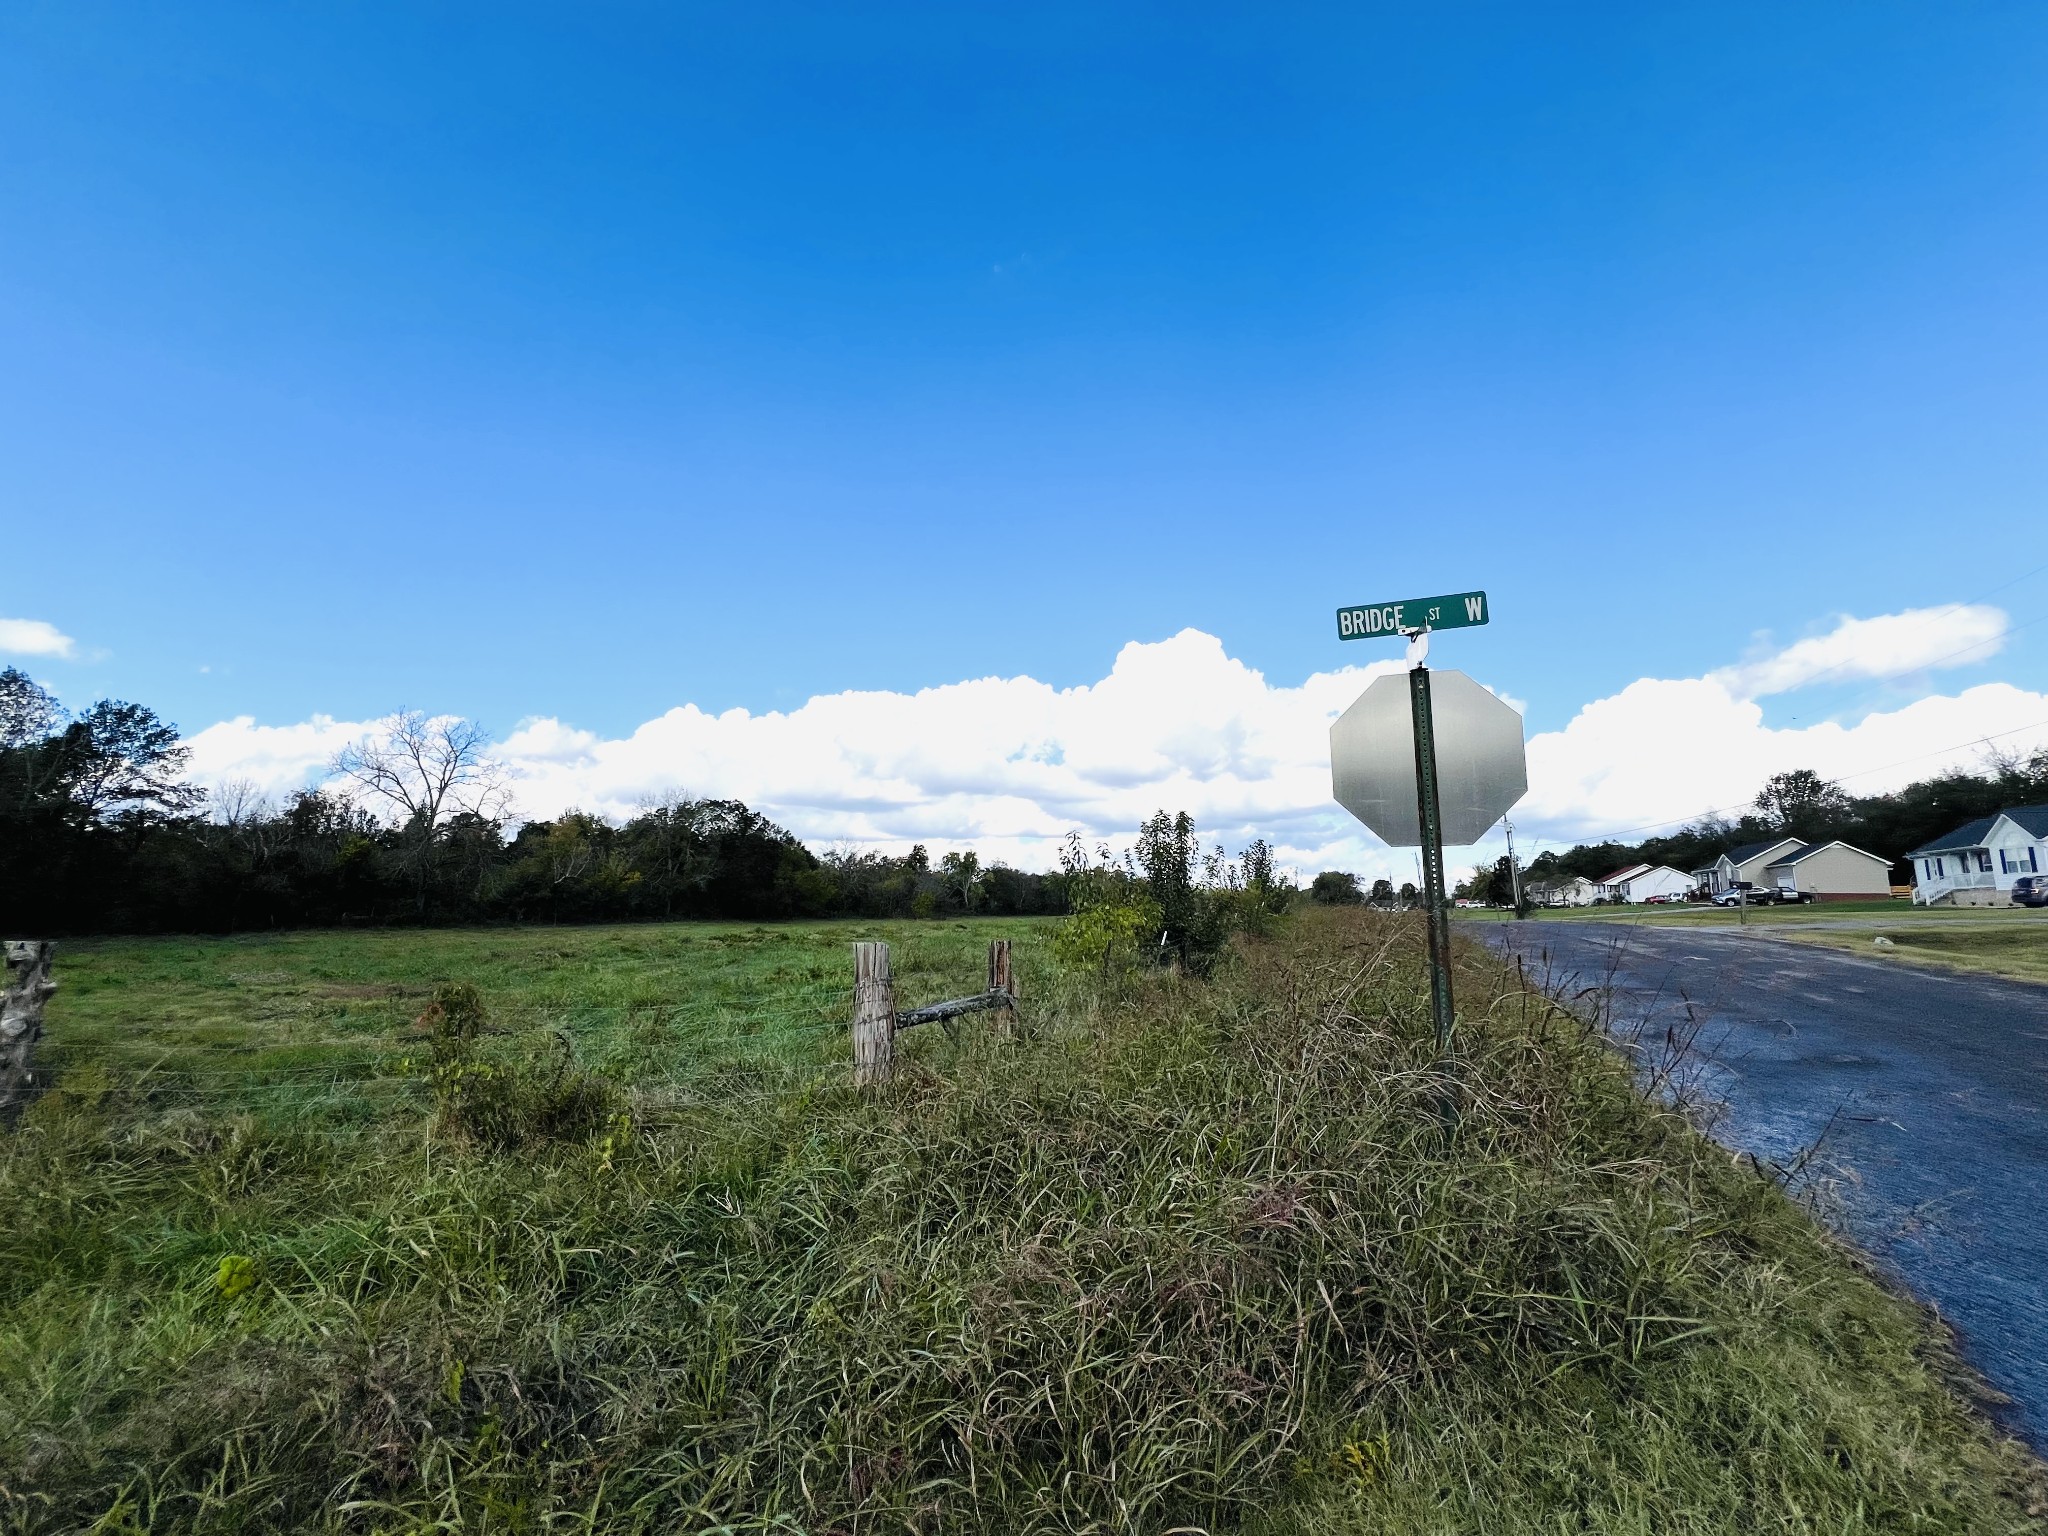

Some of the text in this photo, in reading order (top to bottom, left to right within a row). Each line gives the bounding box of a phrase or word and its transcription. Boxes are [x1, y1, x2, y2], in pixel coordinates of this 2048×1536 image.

[1340, 597, 1482, 636] BRIDGE ST W
